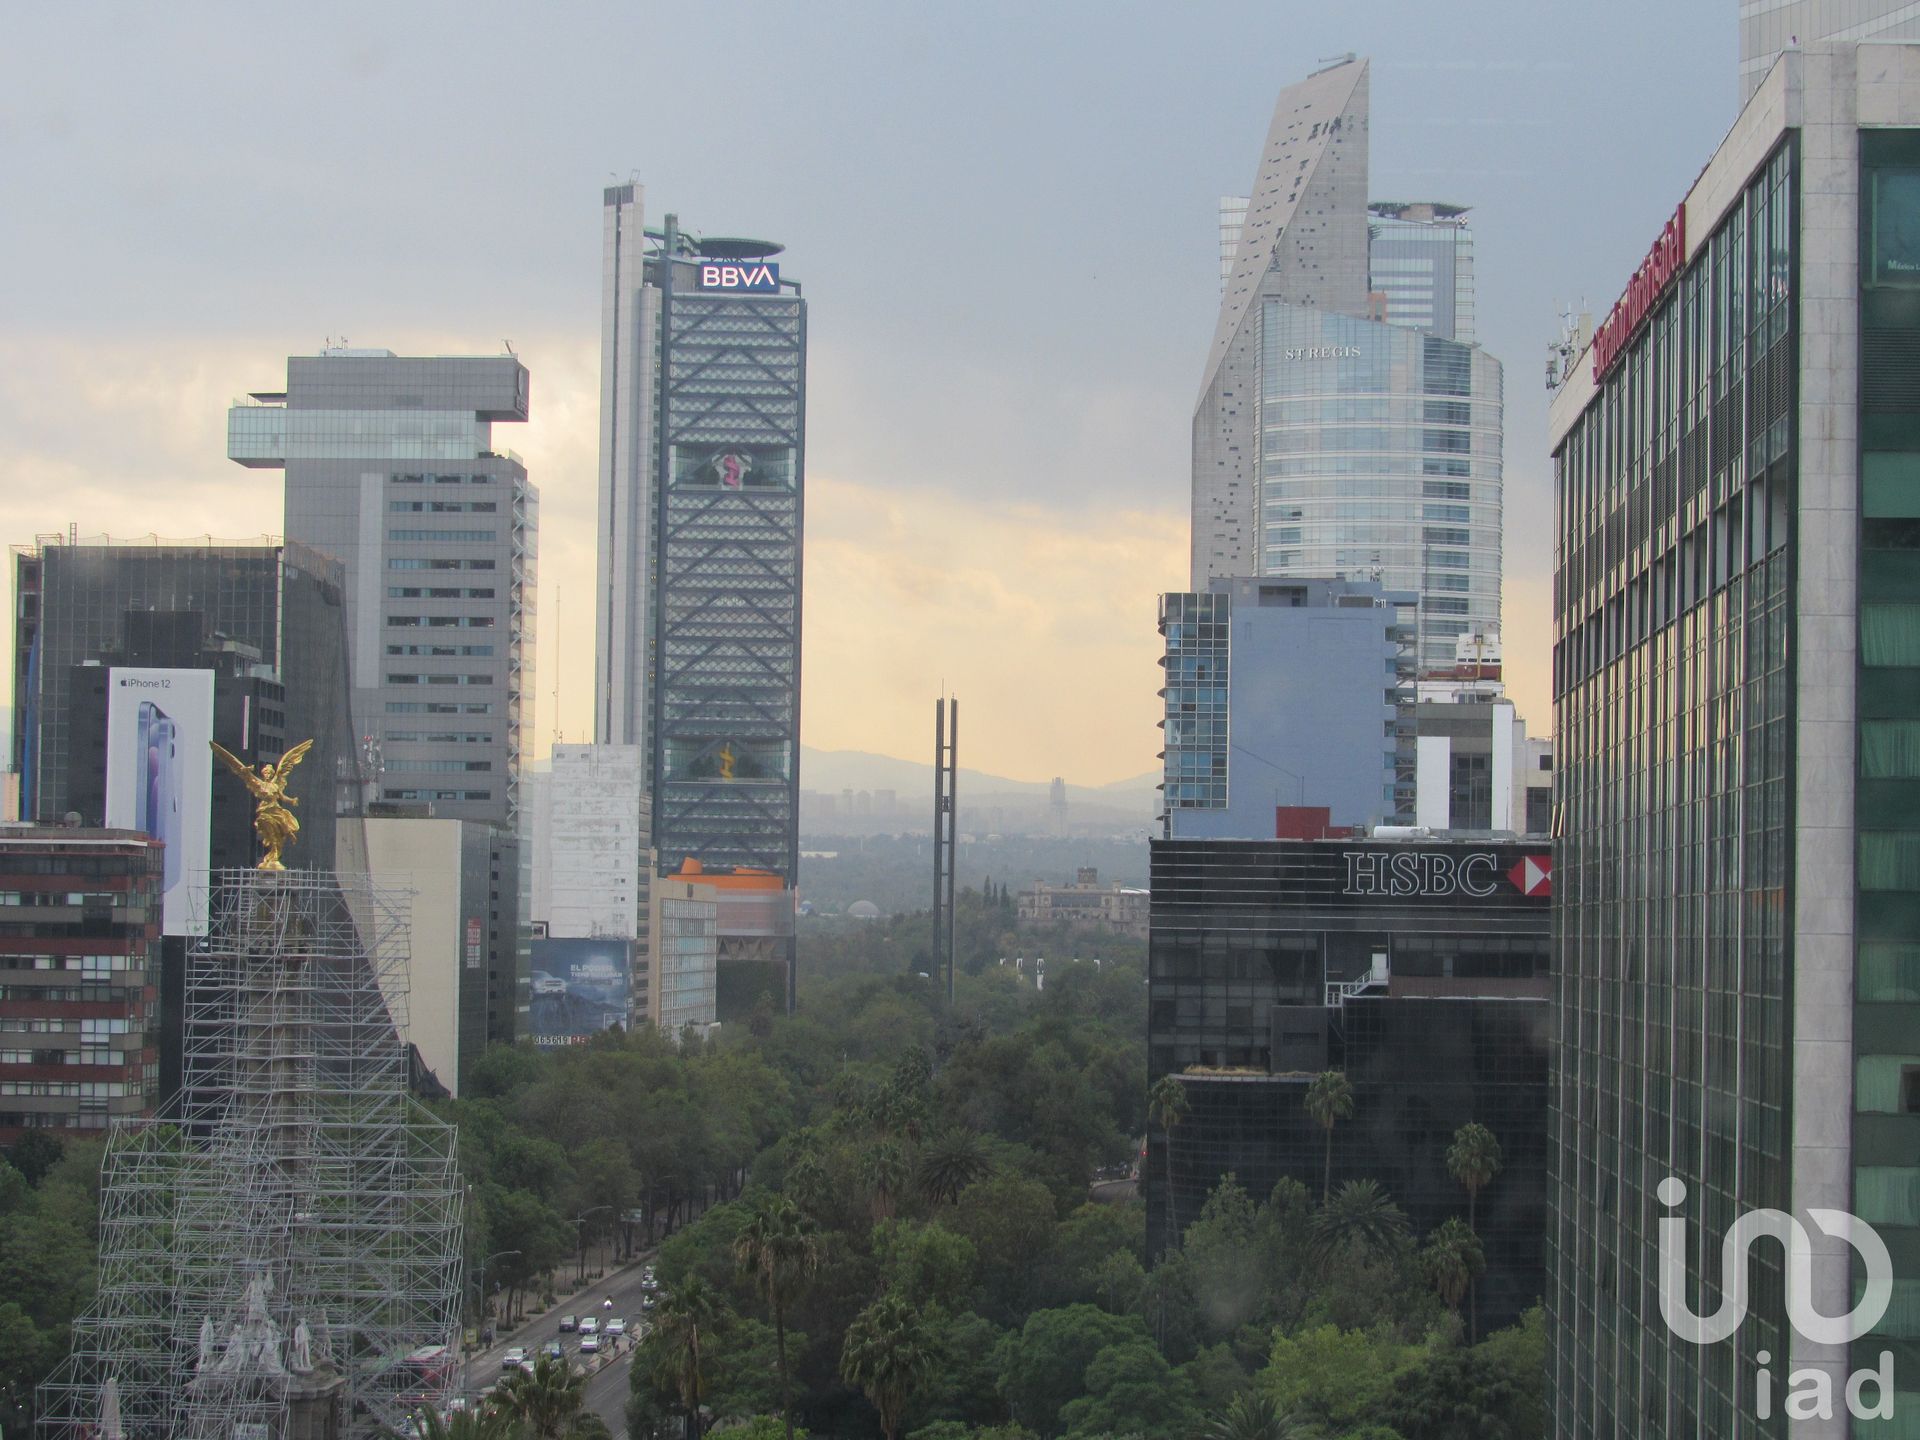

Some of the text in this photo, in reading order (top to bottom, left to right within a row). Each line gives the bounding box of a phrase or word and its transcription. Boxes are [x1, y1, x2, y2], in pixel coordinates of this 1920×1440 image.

[703, 265, 775, 287] BBVA
[1309, 346, 1361, 359] REGIS
[128, 679, 171, 688] iPhone 12
[1343, 852, 1497, 896] HSBC
